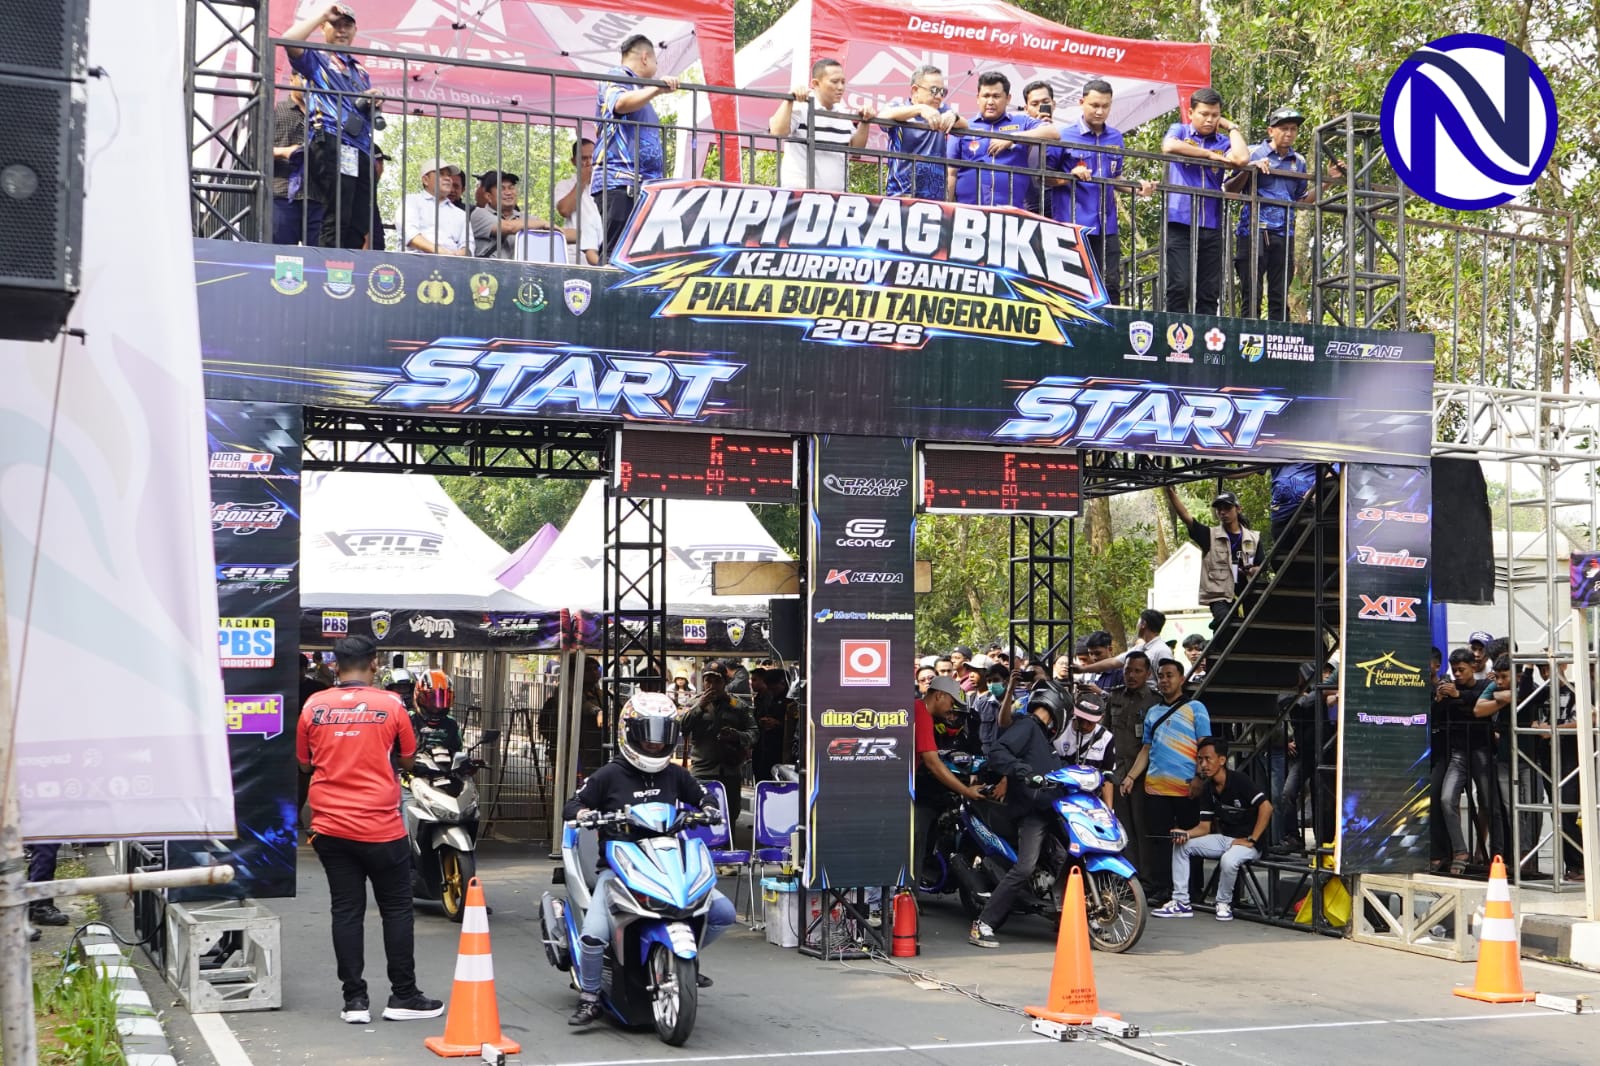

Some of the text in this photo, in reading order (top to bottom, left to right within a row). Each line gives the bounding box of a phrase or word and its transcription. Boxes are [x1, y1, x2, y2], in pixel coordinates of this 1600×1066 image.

[907, 14, 1126, 63] Designed For Your Journey
[630, 188, 1092, 297] KNPI DRAG BIKE
[733, 252, 995, 297] KEJURPROV BANTEN
[687, 281, 1042, 335] PIALA BUPATI TANGERANG
[811, 318, 925, 345] 2026
[1267, 334, 1304, 344] DPD KNPI
[1267, 343, 1314, 353] KABUPATEN
[1325, 341, 1404, 359] POKTANG
[1204, 353, 1225, 365] PMI
[1267, 351, 1314, 362] TANGERANG
[374, 346, 745, 418] START
[991, 384, 1292, 449] START
[213, 452, 241, 462] uma
[210, 460, 249, 471] racing
[851, 572, 903, 583] KENDA
[323, 617, 347, 632] PBS
[684, 626, 706, 638] PBS
